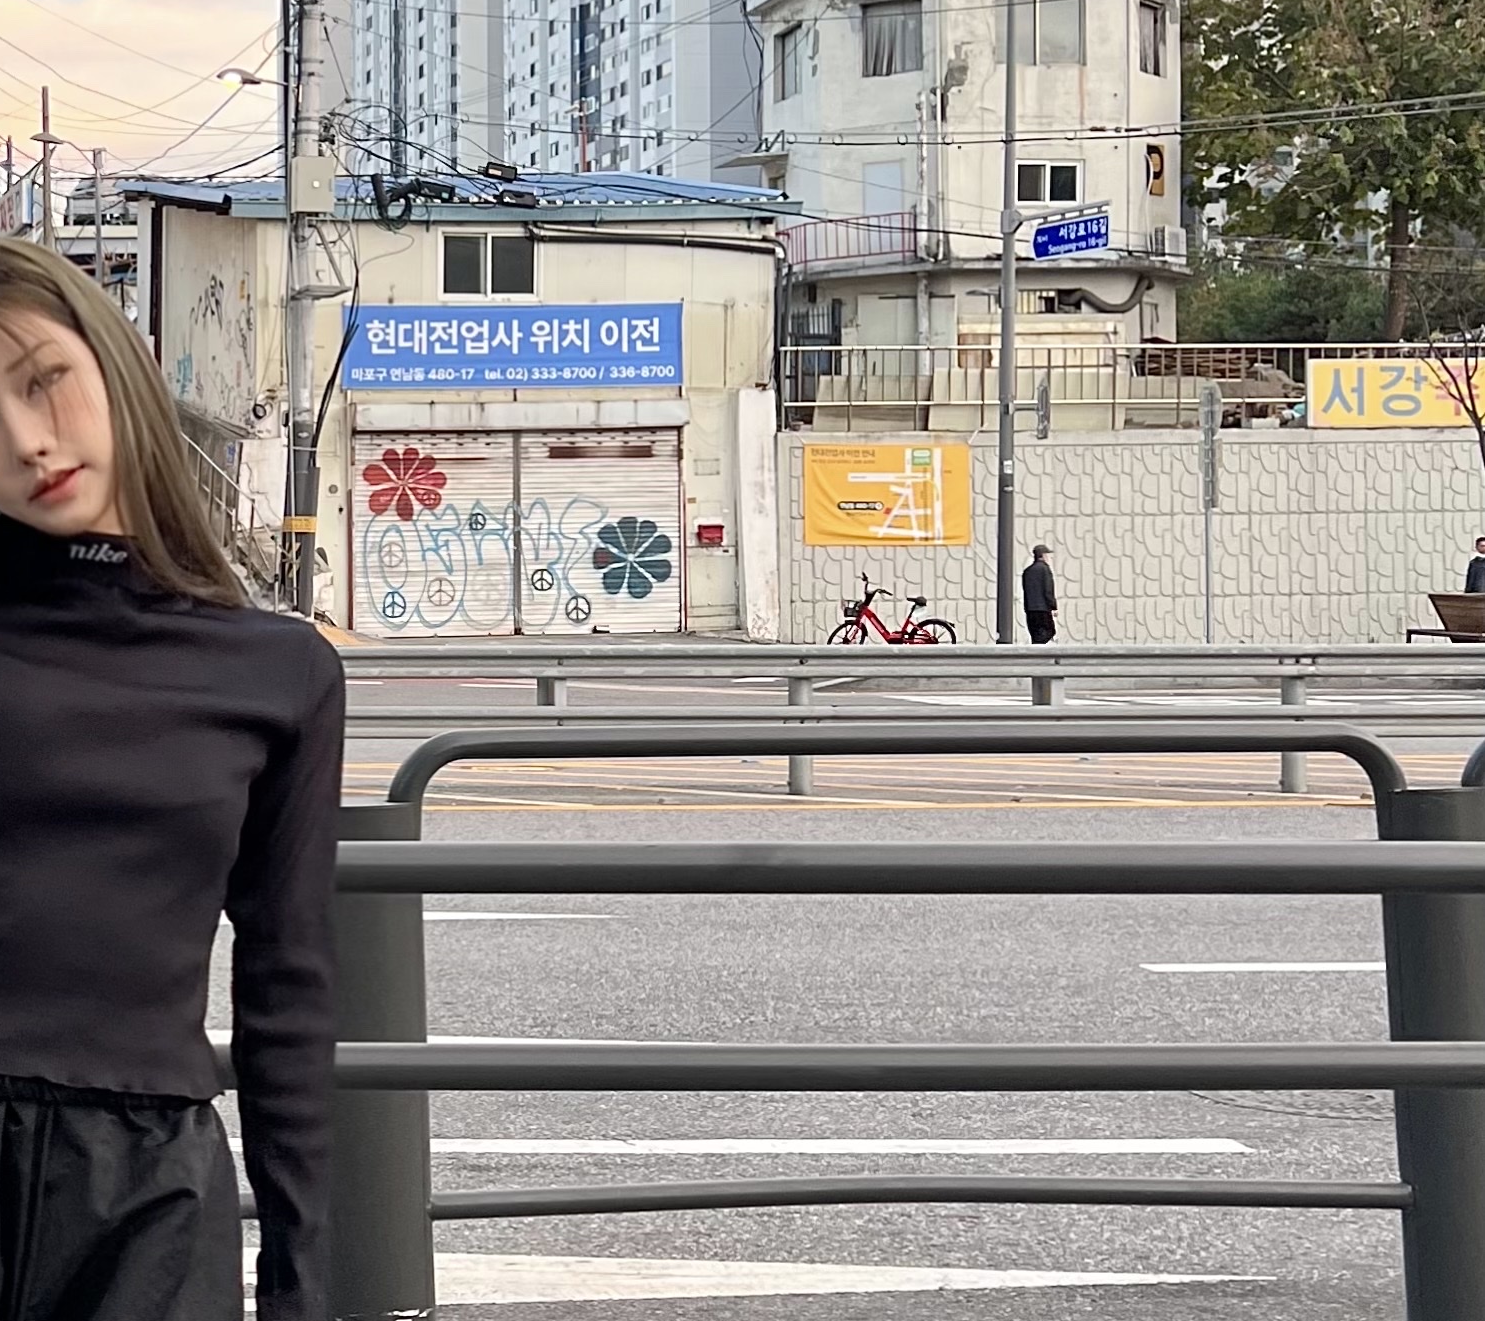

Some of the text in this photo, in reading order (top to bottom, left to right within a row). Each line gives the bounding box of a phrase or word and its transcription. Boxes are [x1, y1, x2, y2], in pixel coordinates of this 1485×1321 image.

[1058, 217, 1108, 240] 서강로16길
[365, 316, 661, 356] 현대전업사 위치 이전
[351, 367, 387, 382] 마포구
[389, 367, 426, 381] 연남동
[427, 368, 475, 381] 480-17
[484, 367, 505, 380] tel.
[506, 367, 529, 382] 02)
[531, 366, 597, 380] 333-8700
[609, 365, 675, 379] 336-8700
[69, 542, 129, 564] nike
